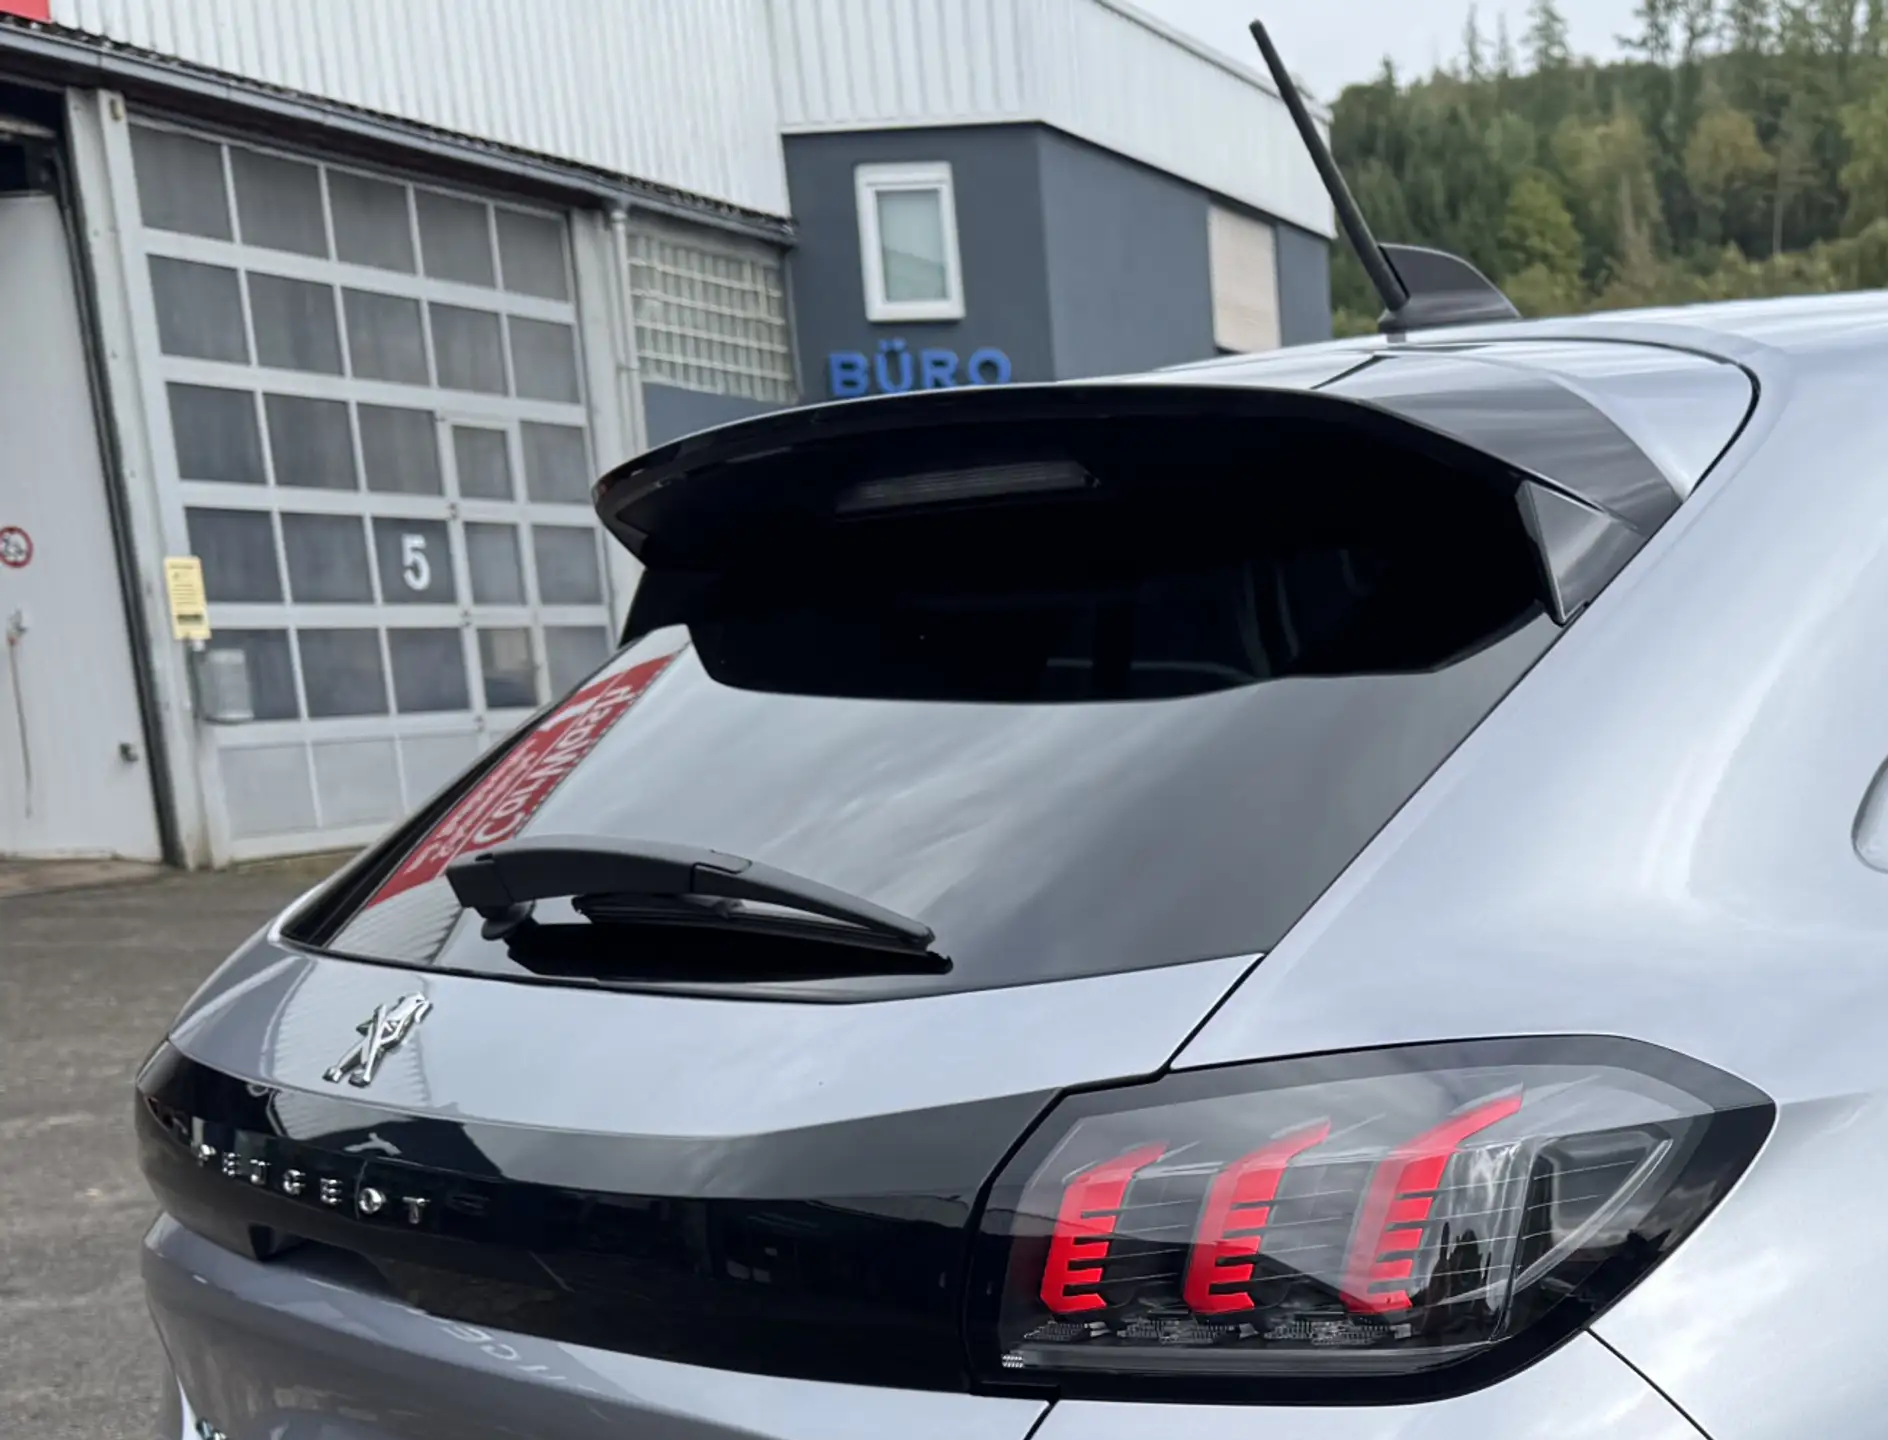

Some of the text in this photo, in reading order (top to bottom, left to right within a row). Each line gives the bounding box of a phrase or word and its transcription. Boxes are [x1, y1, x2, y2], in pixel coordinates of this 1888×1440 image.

[829, 338, 1012, 397] BÜRO
[401, 533, 431, 591] 5
[199, 1143, 430, 1225] PEUGEOT
